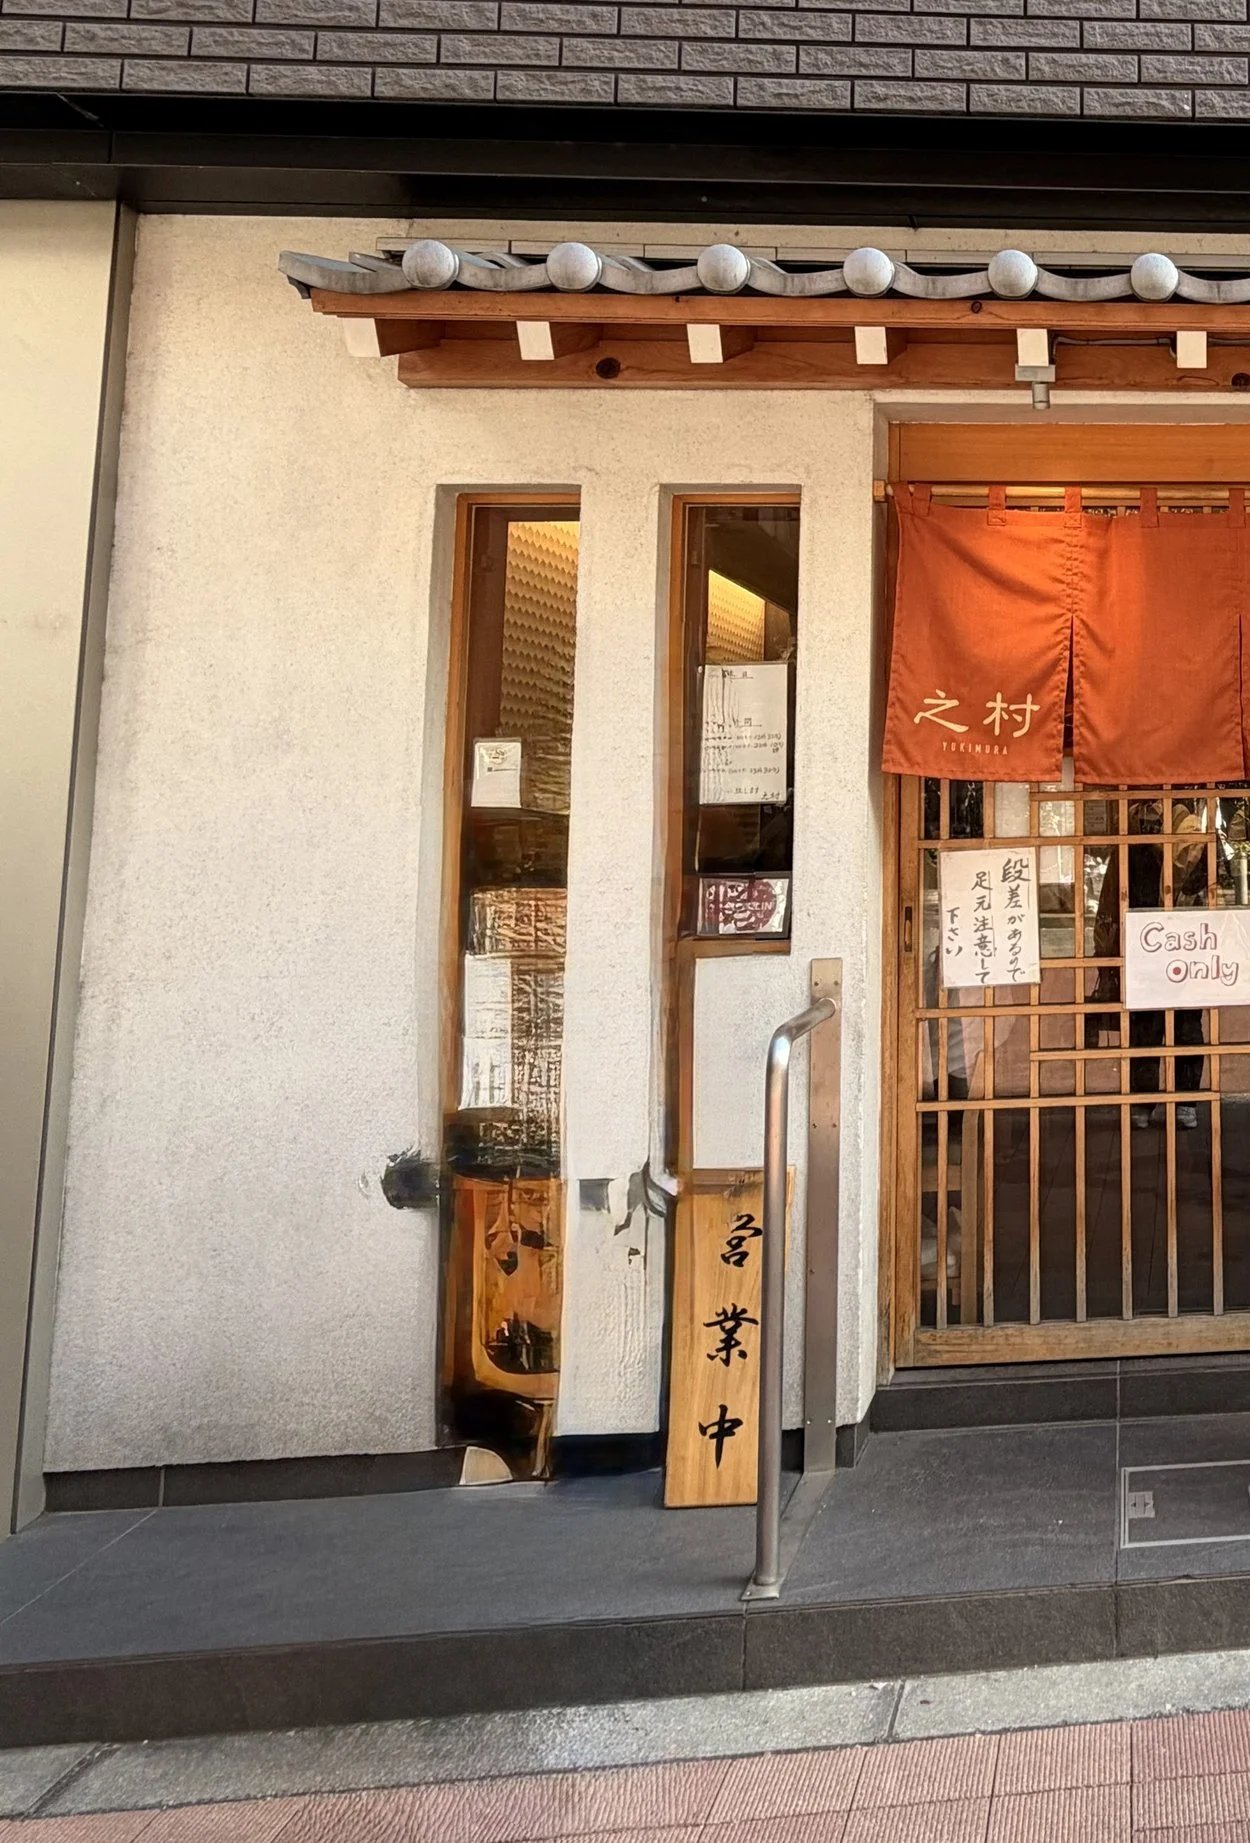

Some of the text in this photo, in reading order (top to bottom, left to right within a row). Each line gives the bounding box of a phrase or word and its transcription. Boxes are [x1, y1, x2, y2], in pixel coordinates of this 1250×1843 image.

[913, 688, 1041, 738] 之村
[941, 741, 1009, 755] YUKIMURA
[946, 906, 963, 957] 下さい
[971, 870, 993, 984] 足元注意して
[1001, 857, 1031, 983] 段差があるので
[1139, 921, 1218, 953] Cash
[697, 1211, 765, 1470] 営業中
